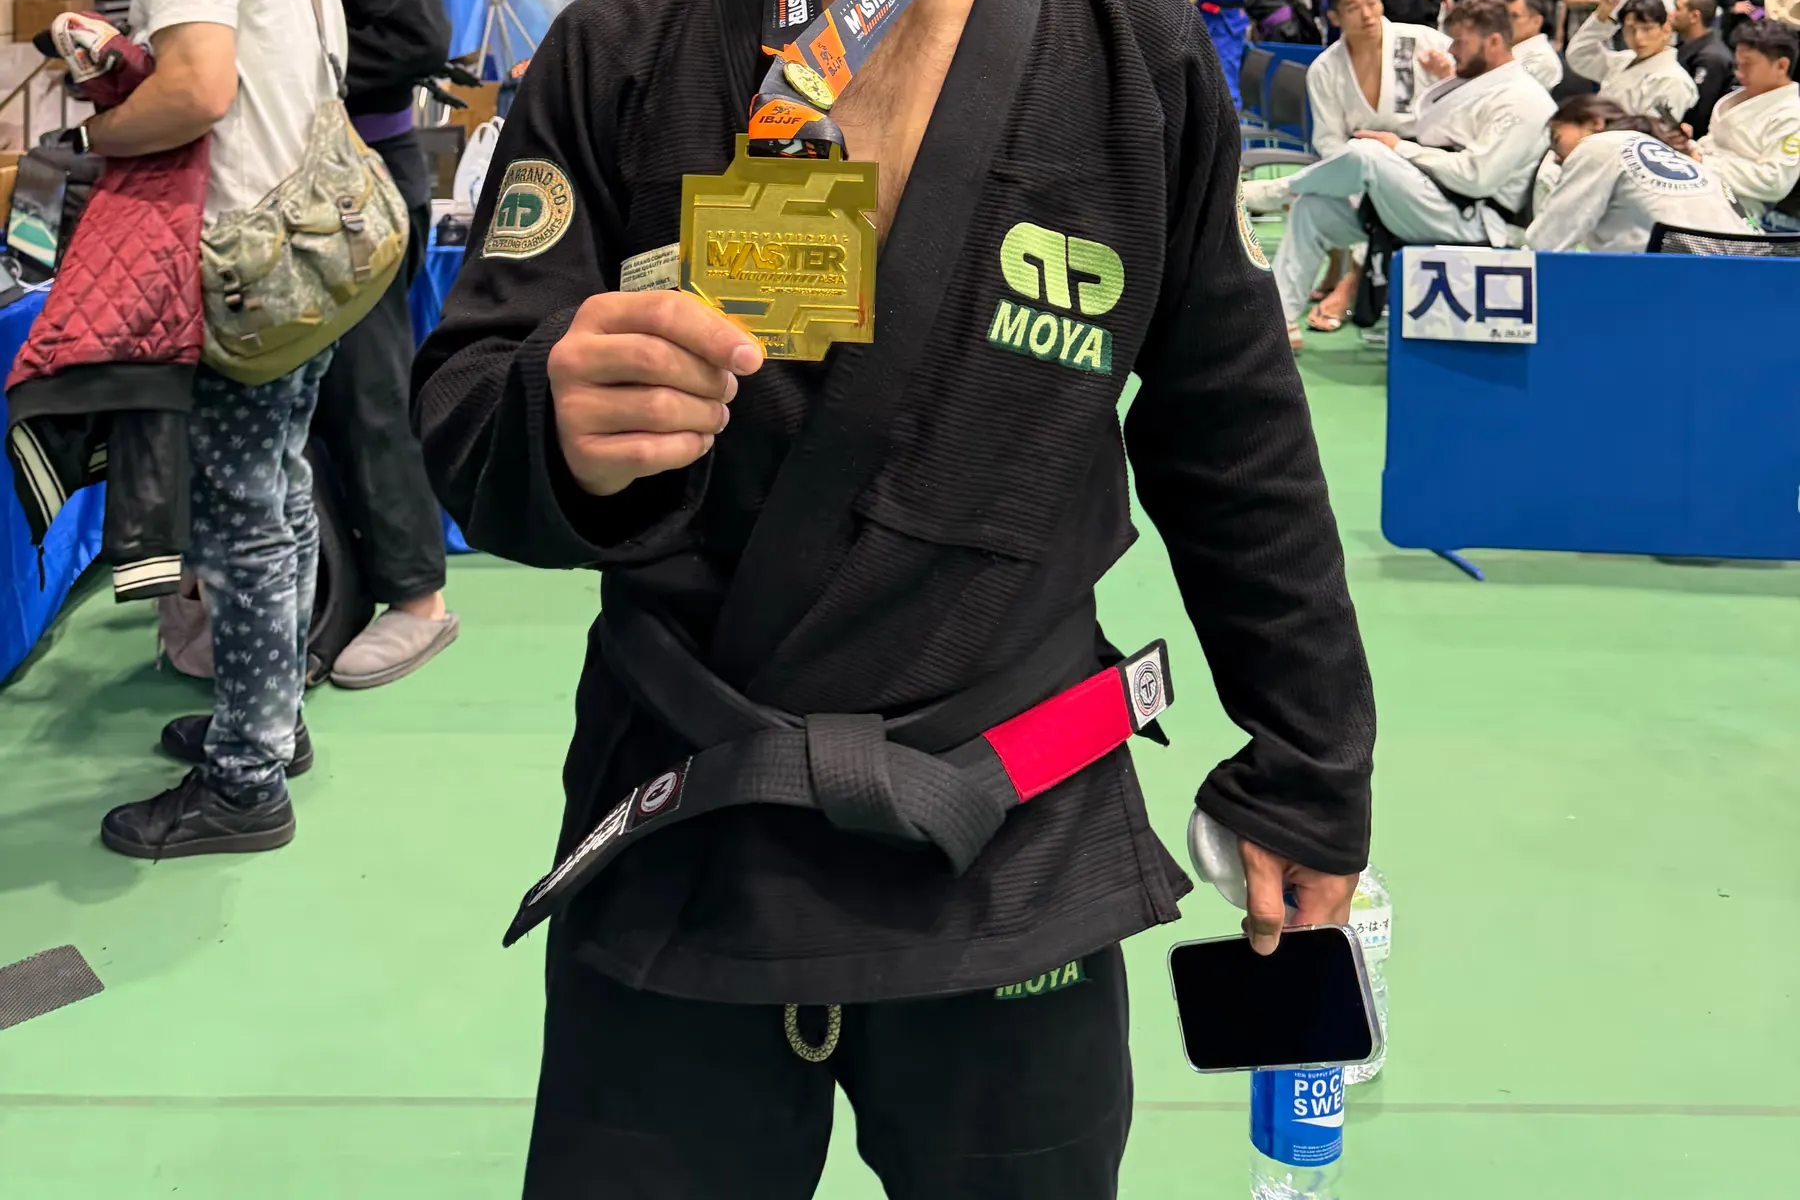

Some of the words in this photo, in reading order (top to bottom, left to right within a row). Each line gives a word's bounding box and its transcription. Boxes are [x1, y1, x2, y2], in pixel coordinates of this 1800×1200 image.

[758, 115, 802, 125] IBJJF
[521, 217, 562, 249] GARMENTS
[707, 230, 849, 242] INTERNATIONAL
[707, 240, 848, 273] MASTER
[1408, 261, 1533, 325] 入口
[989, 300, 1105, 369] MOYA
[1293, 1090, 1344, 1116] SWE
